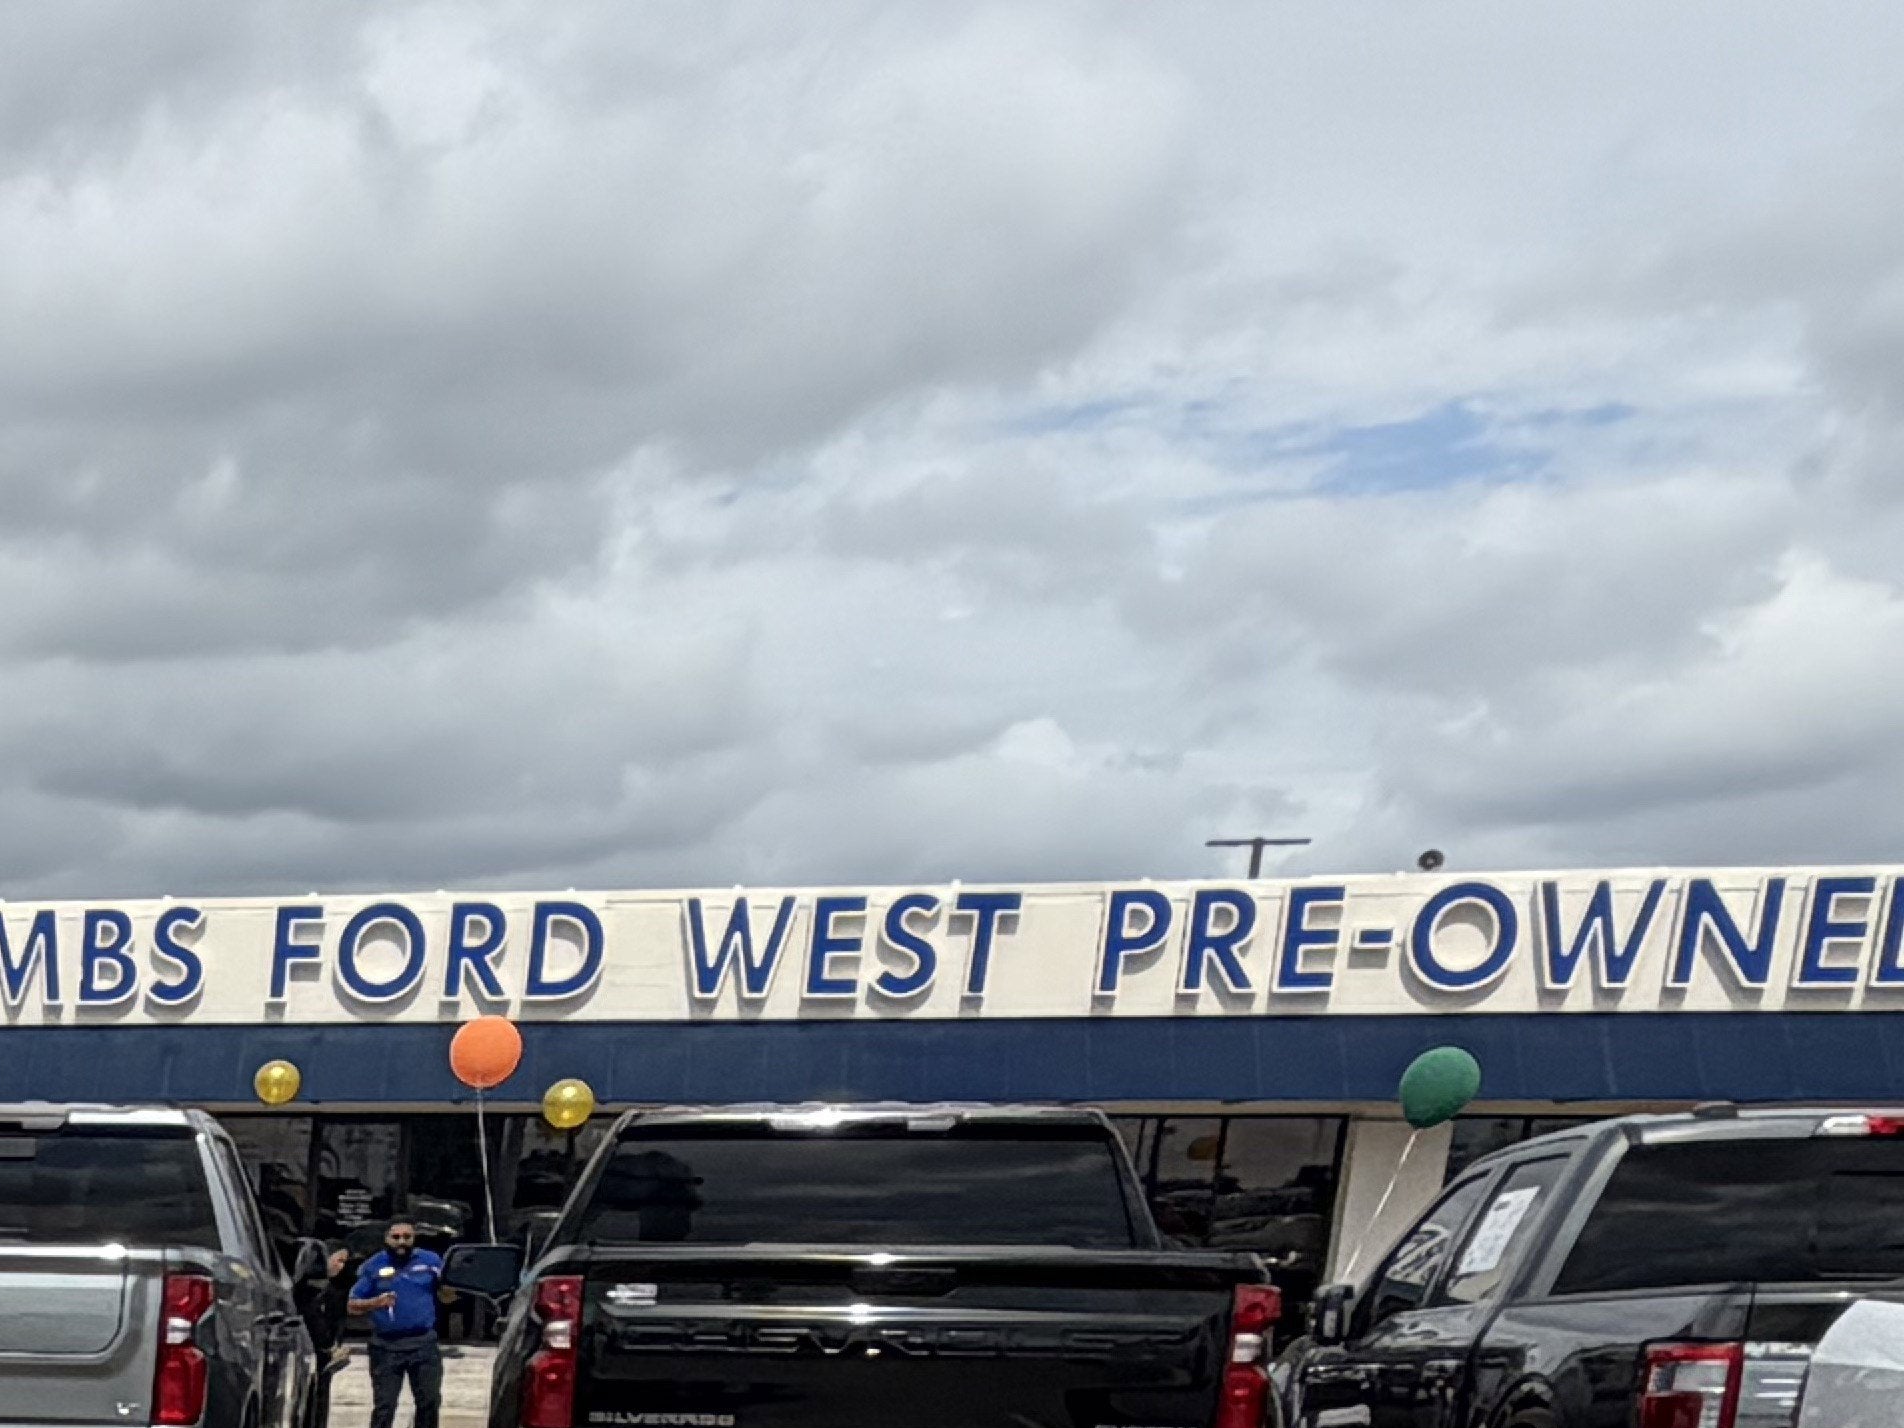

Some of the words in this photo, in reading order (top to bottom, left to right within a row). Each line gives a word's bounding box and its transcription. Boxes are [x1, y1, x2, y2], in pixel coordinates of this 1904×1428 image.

[267, 901, 607, 1002] FORD
[687, 891, 1024, 998] WEST
[1096, 876, 1904, 995] PRE-OWNE
